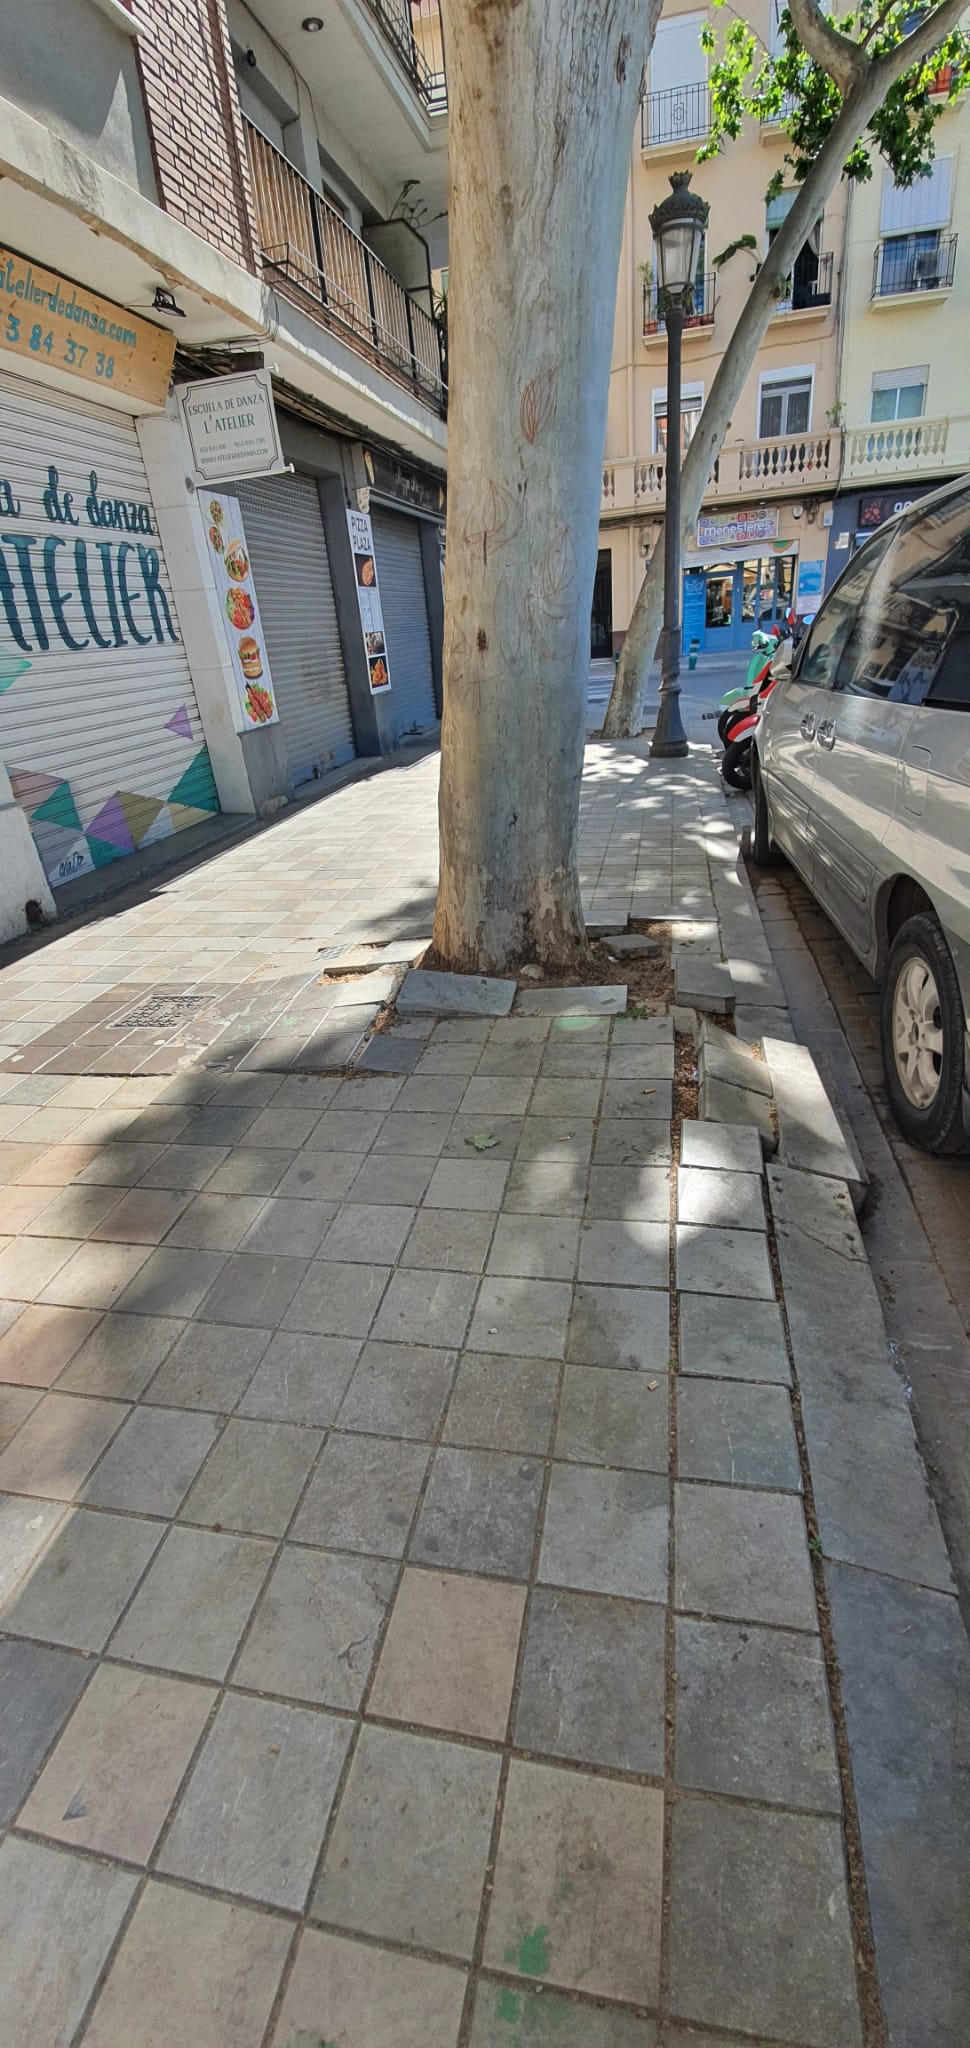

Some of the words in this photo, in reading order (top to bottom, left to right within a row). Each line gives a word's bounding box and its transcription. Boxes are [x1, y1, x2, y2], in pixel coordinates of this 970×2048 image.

[95, 351, 115, 380] 38
[188, 400, 223, 416] ESCUELA
[224, 398, 235, 410] DE
[236, 393, 264, 408] DANZA
[43, 465, 79, 526] de
[86, 470, 156, 536] danza
[351, 516, 369, 533] PIZZA
[352, 535, 371, 551] PLAZA
